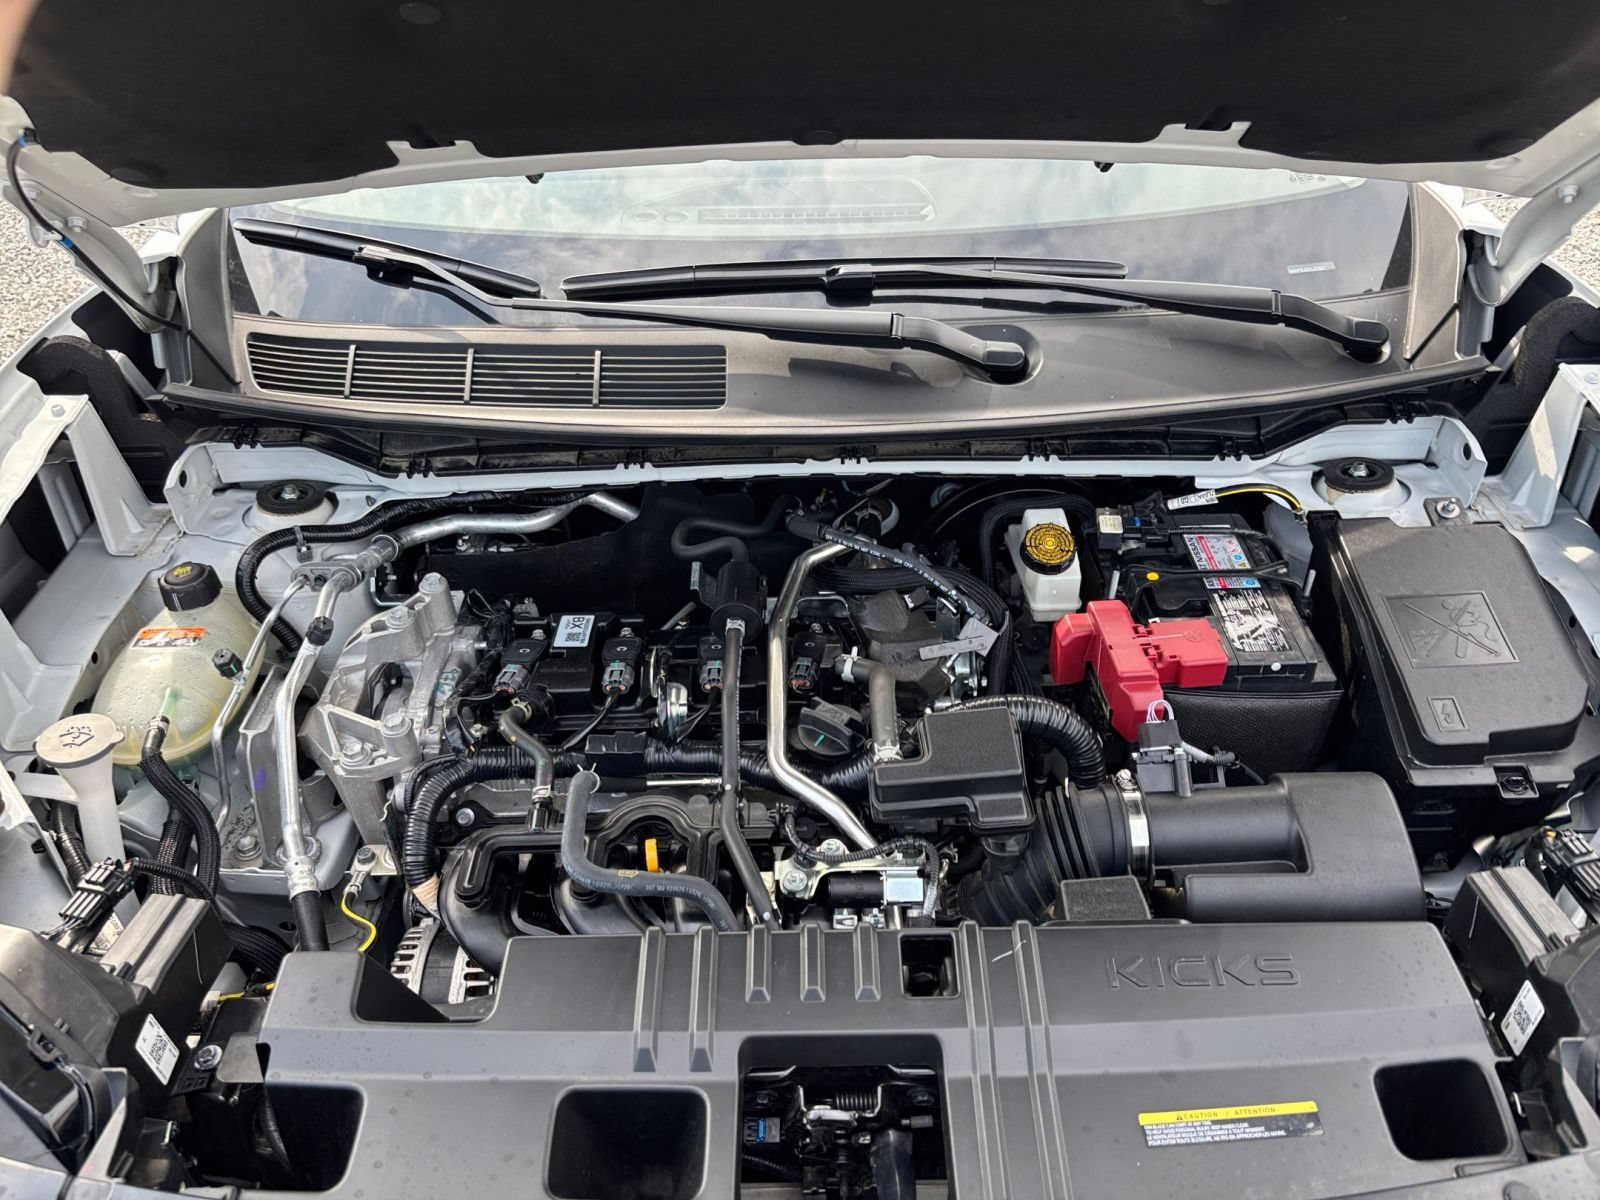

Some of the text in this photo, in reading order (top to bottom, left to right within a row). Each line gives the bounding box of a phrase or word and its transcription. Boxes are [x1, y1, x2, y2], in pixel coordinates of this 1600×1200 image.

[1187, 537, 1204, 562] NISSAN
[570, 616, 584, 630] BX
[1106, 954, 1300, 990] KICKS
[1234, 1107, 1276, 1115] ATTENTION
